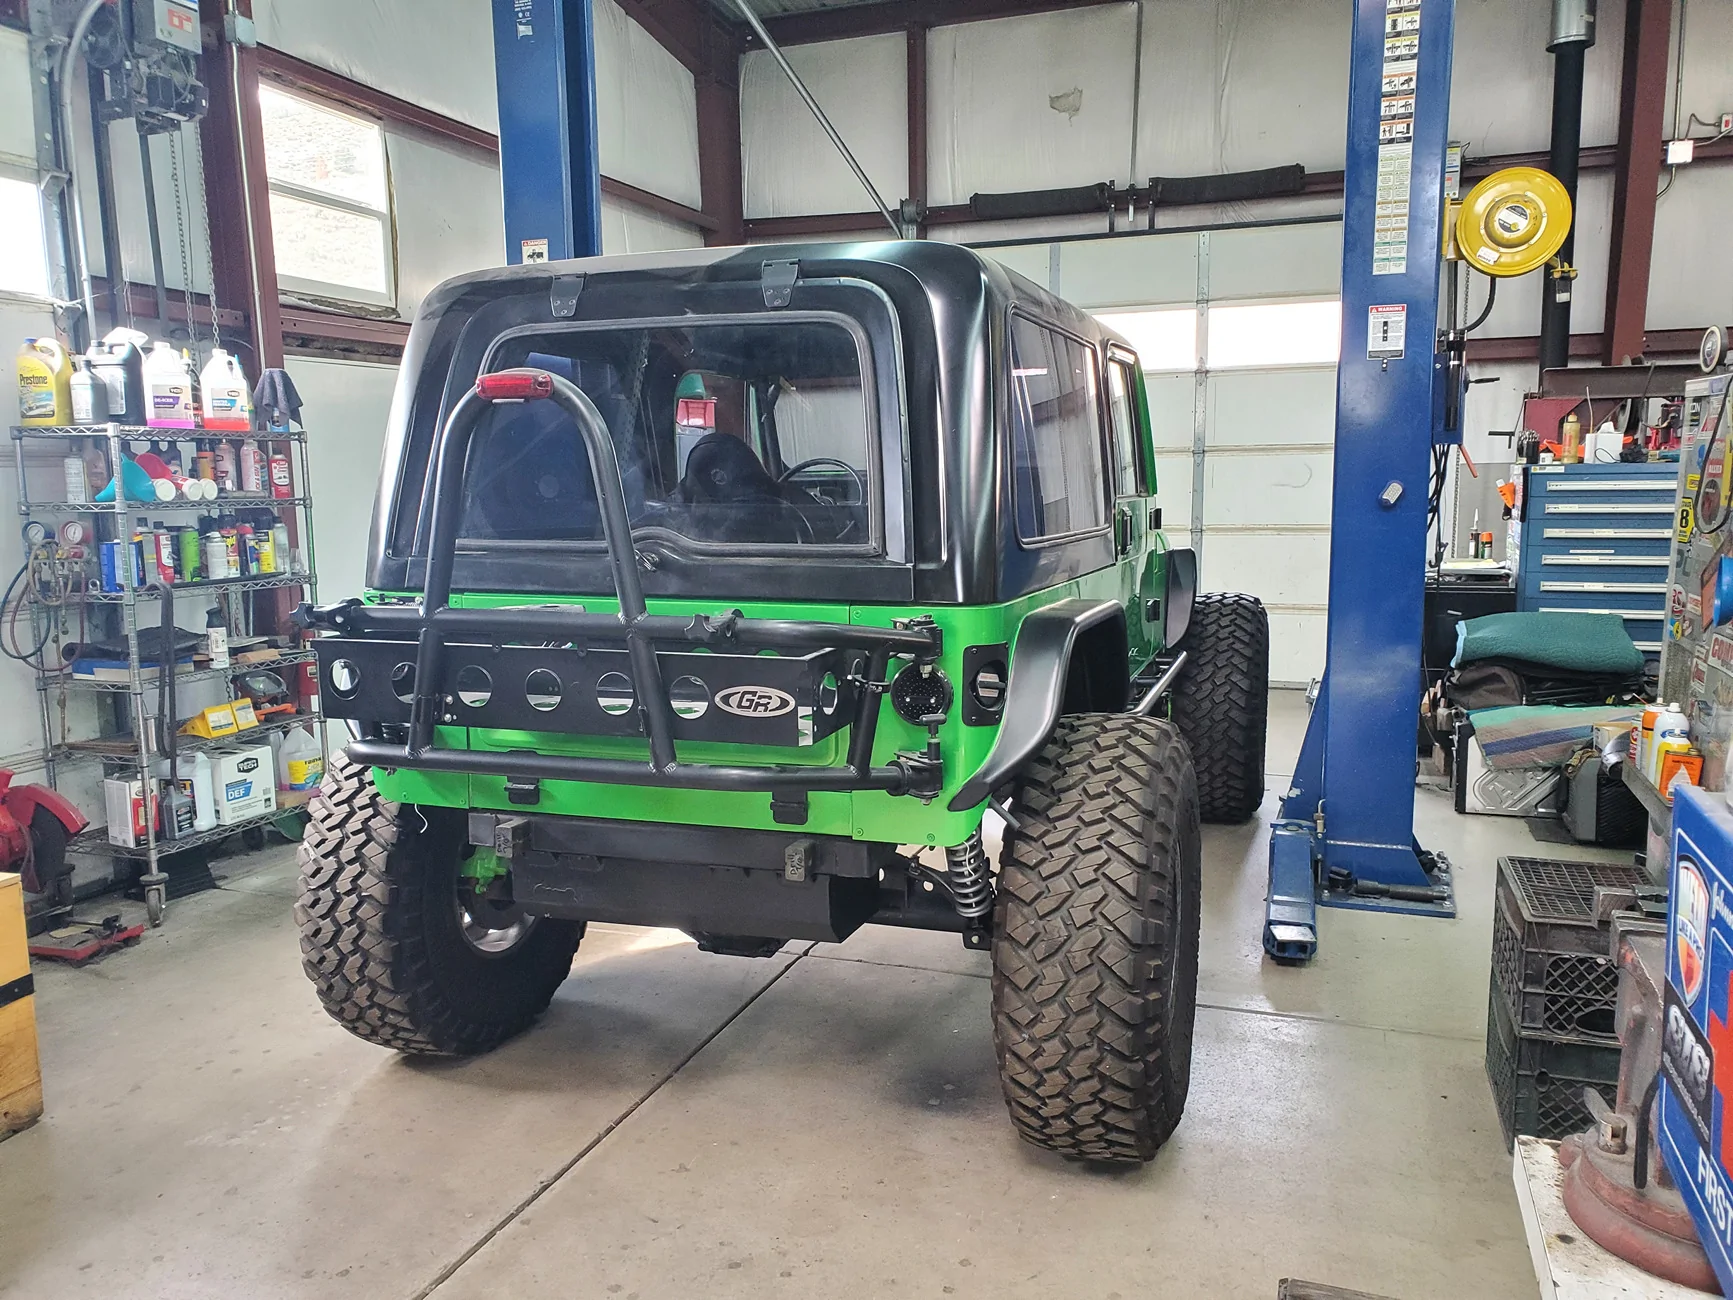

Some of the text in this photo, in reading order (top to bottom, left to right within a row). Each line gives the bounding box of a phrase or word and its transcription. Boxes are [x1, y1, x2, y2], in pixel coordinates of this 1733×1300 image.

[19, 373, 48, 385] Prestone
[1680, 508, 1690, 529] 8
[736, 690, 773, 713] GR
[239, 763, 258, 772] TECH
[228, 788, 246, 800] DEF
[1698, 1146, 1733, 1246] FIRST
